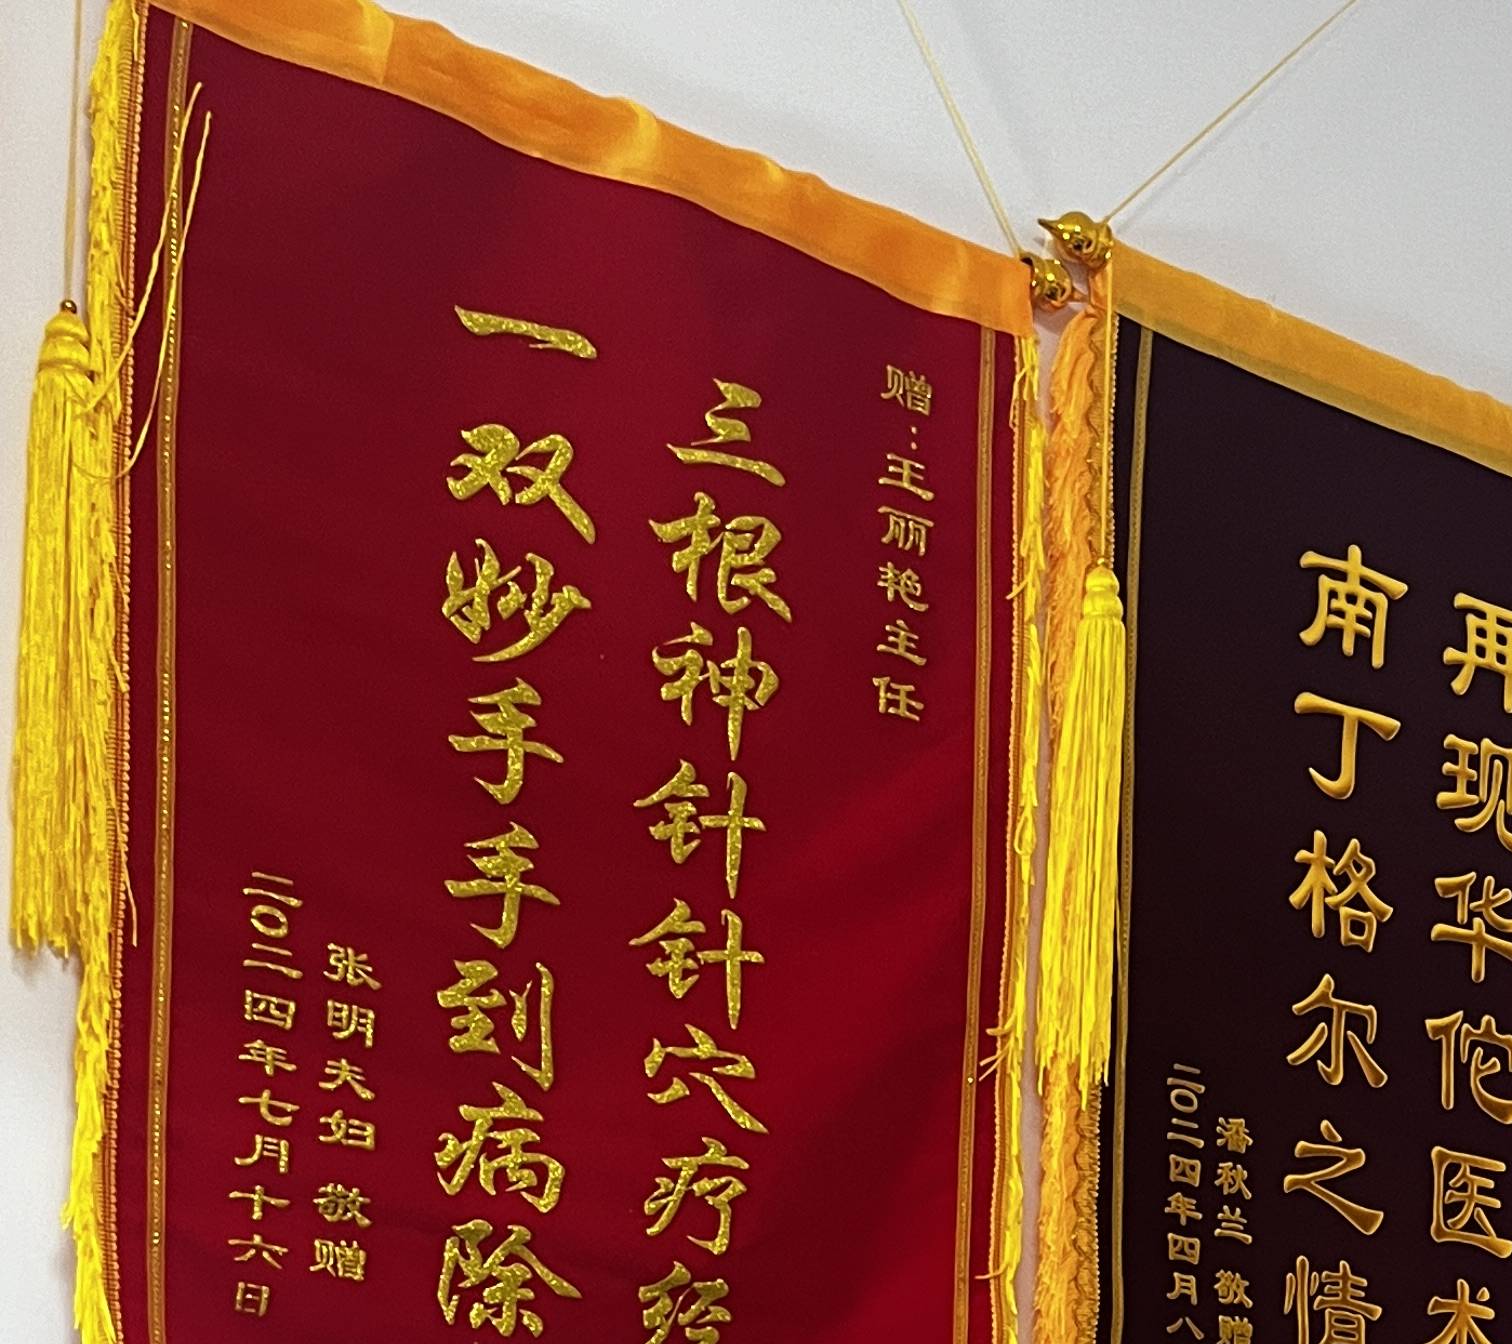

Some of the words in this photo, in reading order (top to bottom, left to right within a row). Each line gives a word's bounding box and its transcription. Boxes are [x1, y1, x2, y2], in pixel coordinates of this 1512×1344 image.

[434, 304, 598, 1338] 一双妙手手到病除
[309, 1183, 373, 1281] 敬赠
